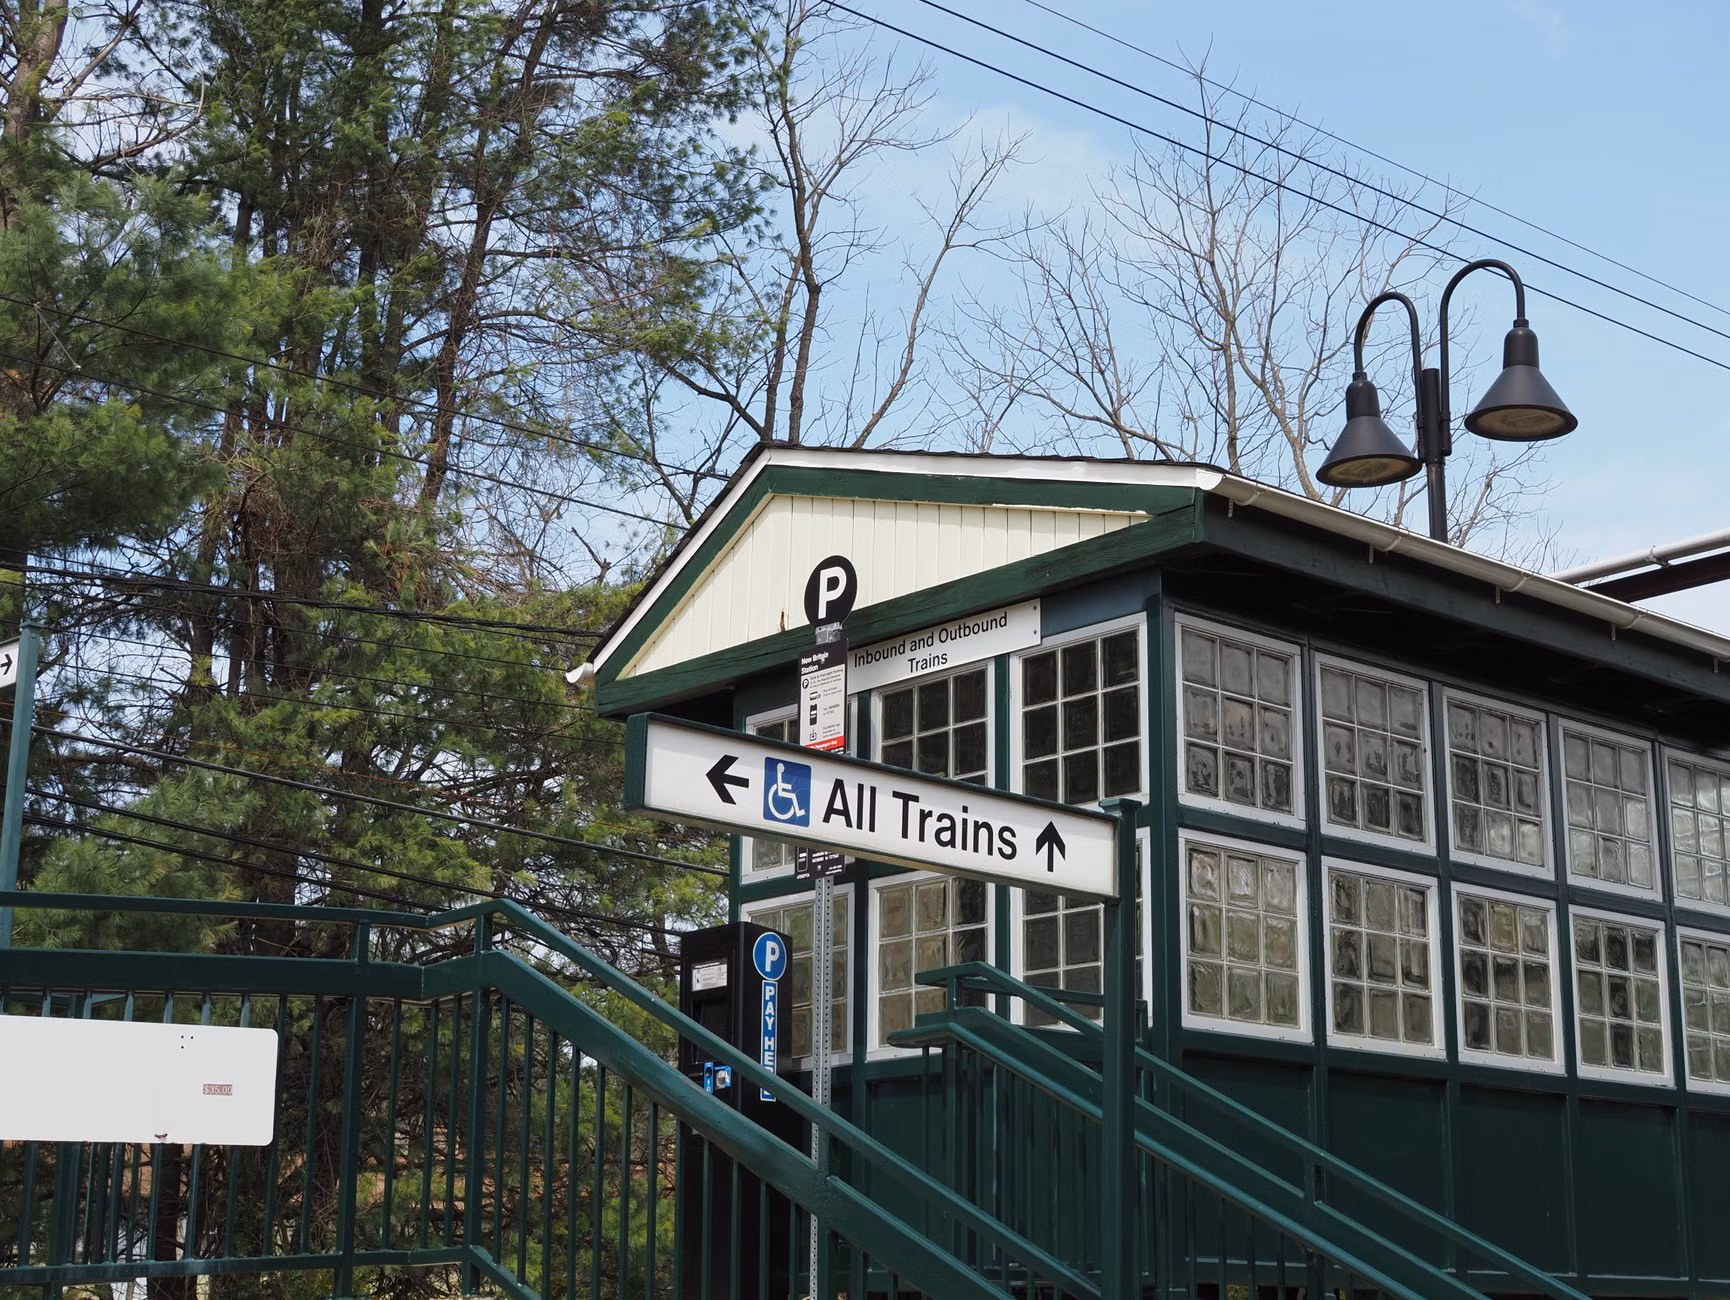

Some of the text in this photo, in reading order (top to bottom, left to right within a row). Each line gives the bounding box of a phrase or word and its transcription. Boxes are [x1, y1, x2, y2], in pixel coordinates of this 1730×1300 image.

[818, 566, 847, 620] P
[854, 611, 1008, 668] Inbound and Outbound
[801, 652, 829, 665] New Britain
[801, 665, 819, 674] Station
[908, 652, 948, 673] Trains
[822, 778, 1017, 861] All Trains
[764, 940, 780, 973] P
[763, 986, 776, 1096] PAY HE
[203, 1085, 233, 1095] $35.00
